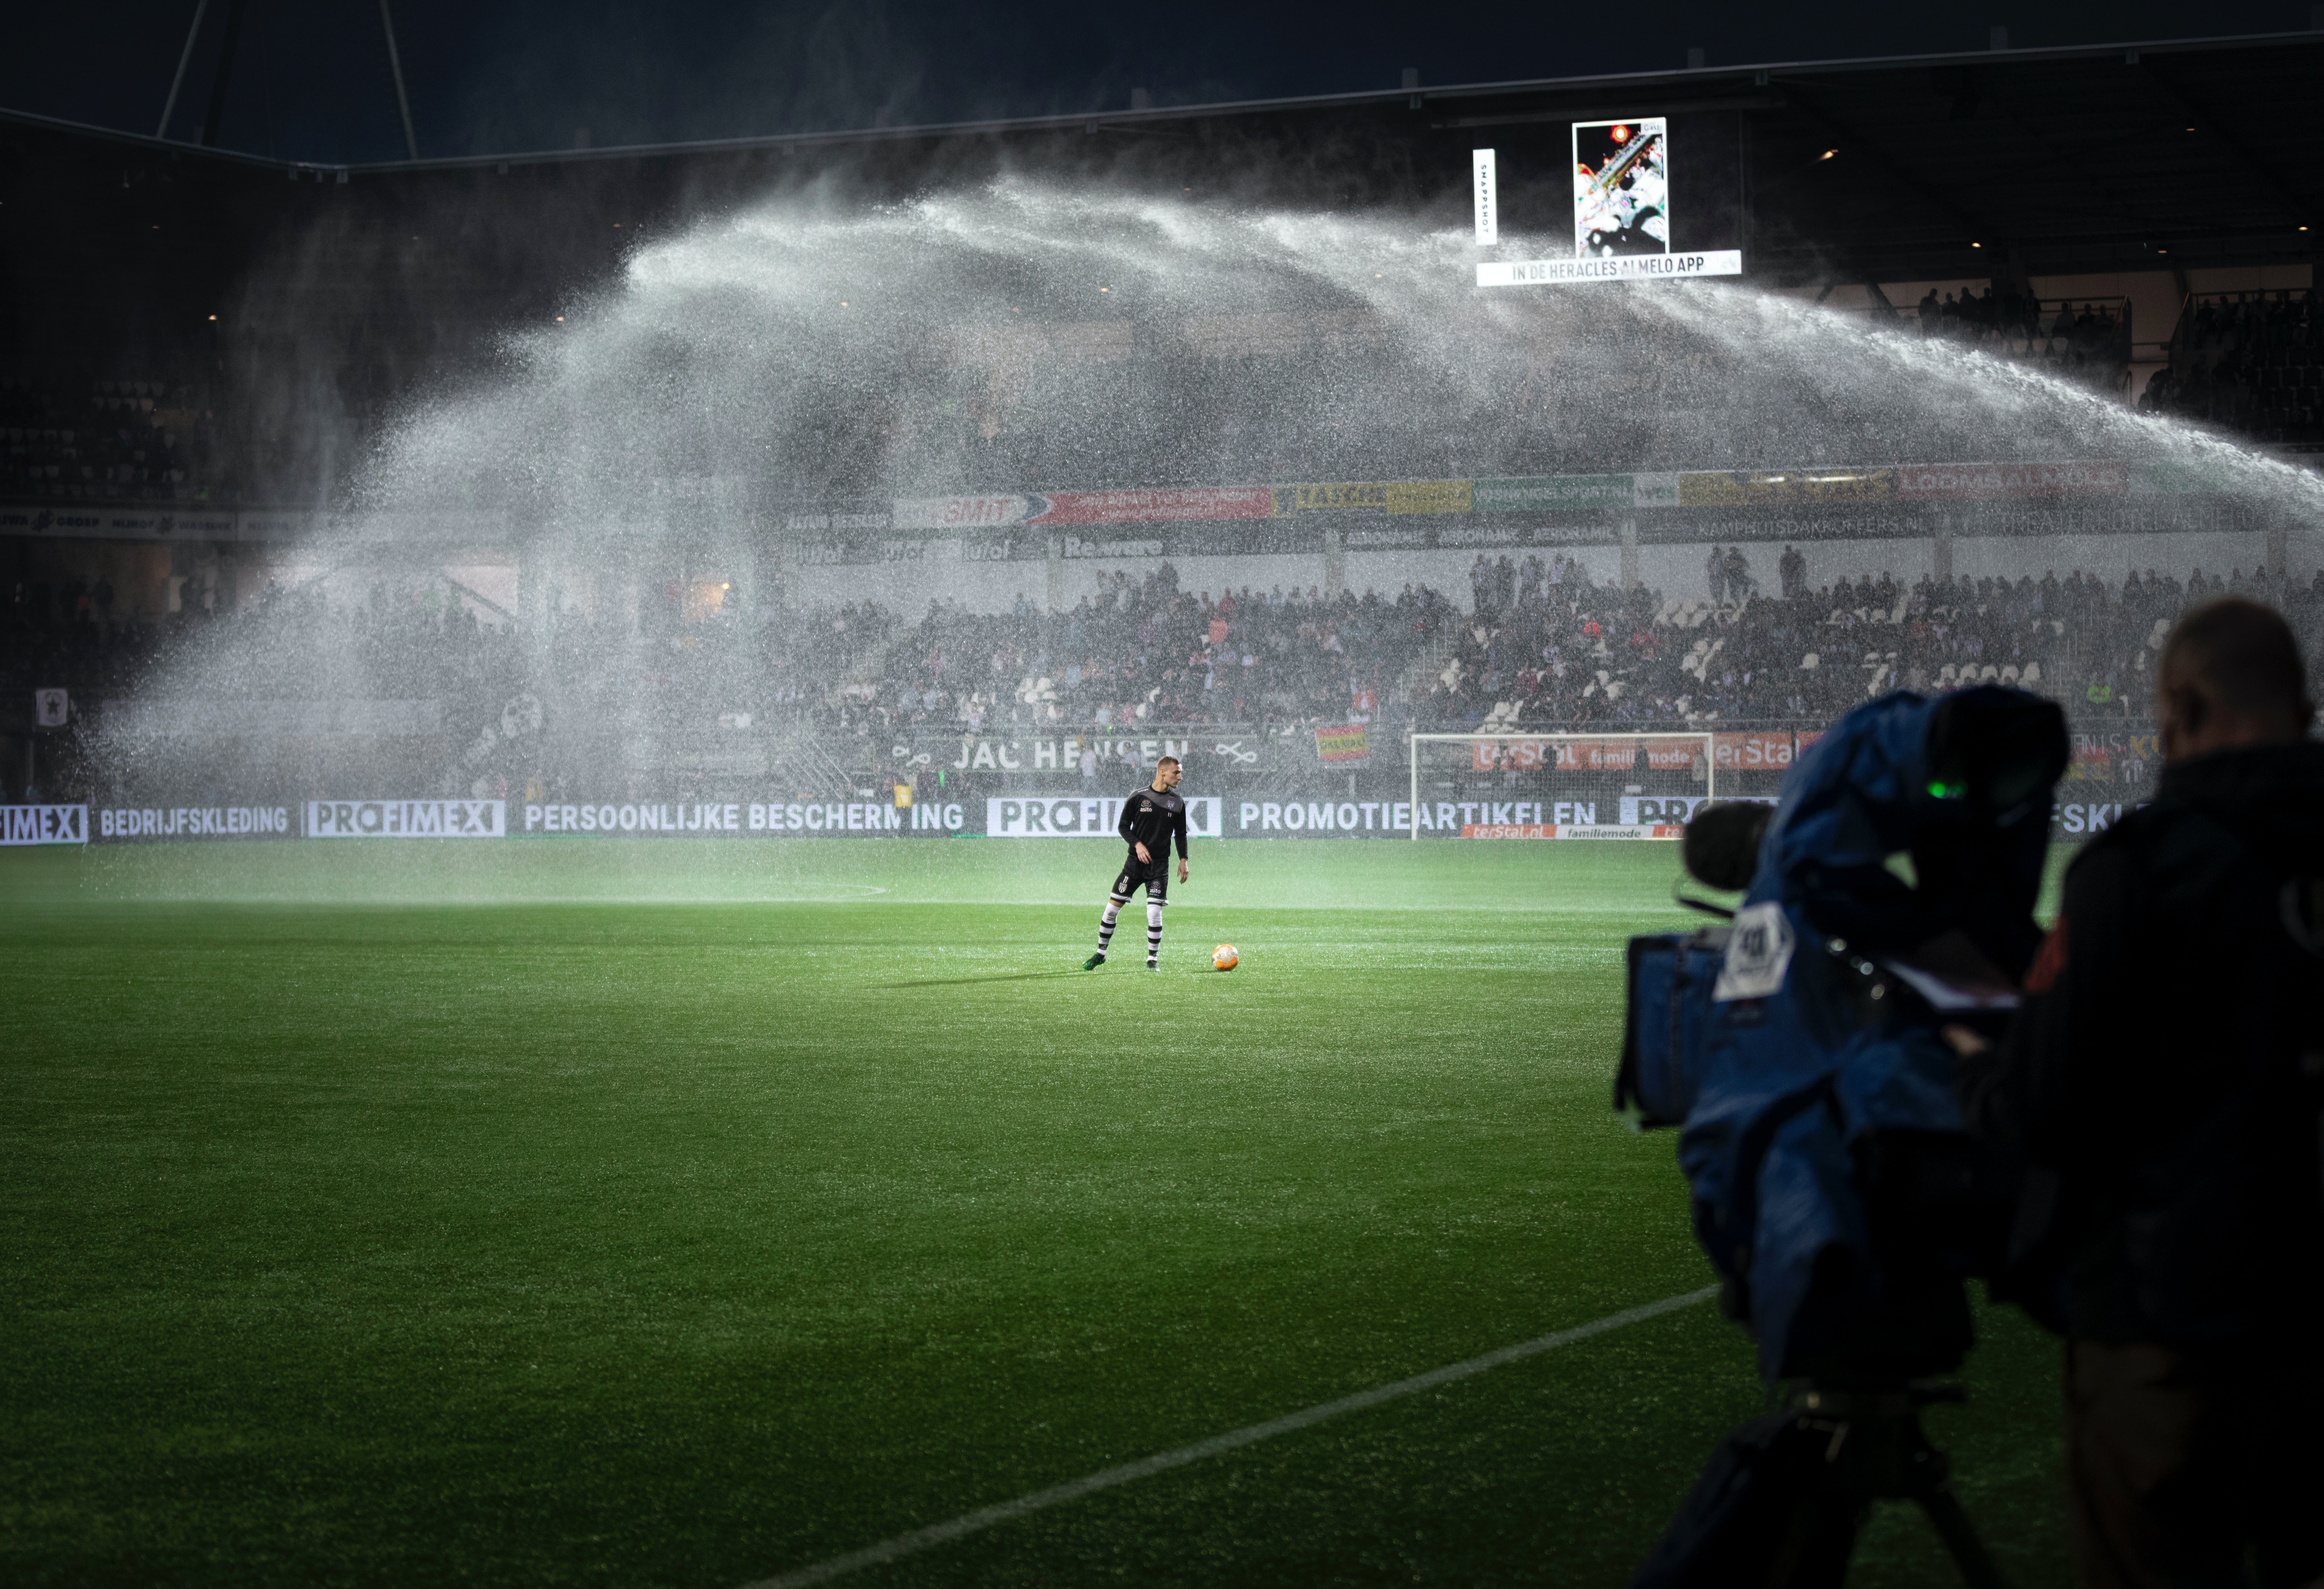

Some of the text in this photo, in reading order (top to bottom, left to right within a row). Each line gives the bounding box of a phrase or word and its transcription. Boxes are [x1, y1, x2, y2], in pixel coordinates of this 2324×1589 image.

[1512, 266, 1526, 281] IN
[1530, 265, 1546, 280] DE
[1549, 261, 1618, 279] HERACLES
[1677, 256, 1704, 273] APP
[1590, 749, 1690, 764] familimode
[0, 807, 77, 840] IMEX
[100, 806, 288, 837] BEDRIJFSKLEDING
[317, 803, 490, 833] PROFIMEX
[525, 804, 740, 831] PERSOONLIJKE
[1473, 825, 1641, 838] terStal.nl familiemode
